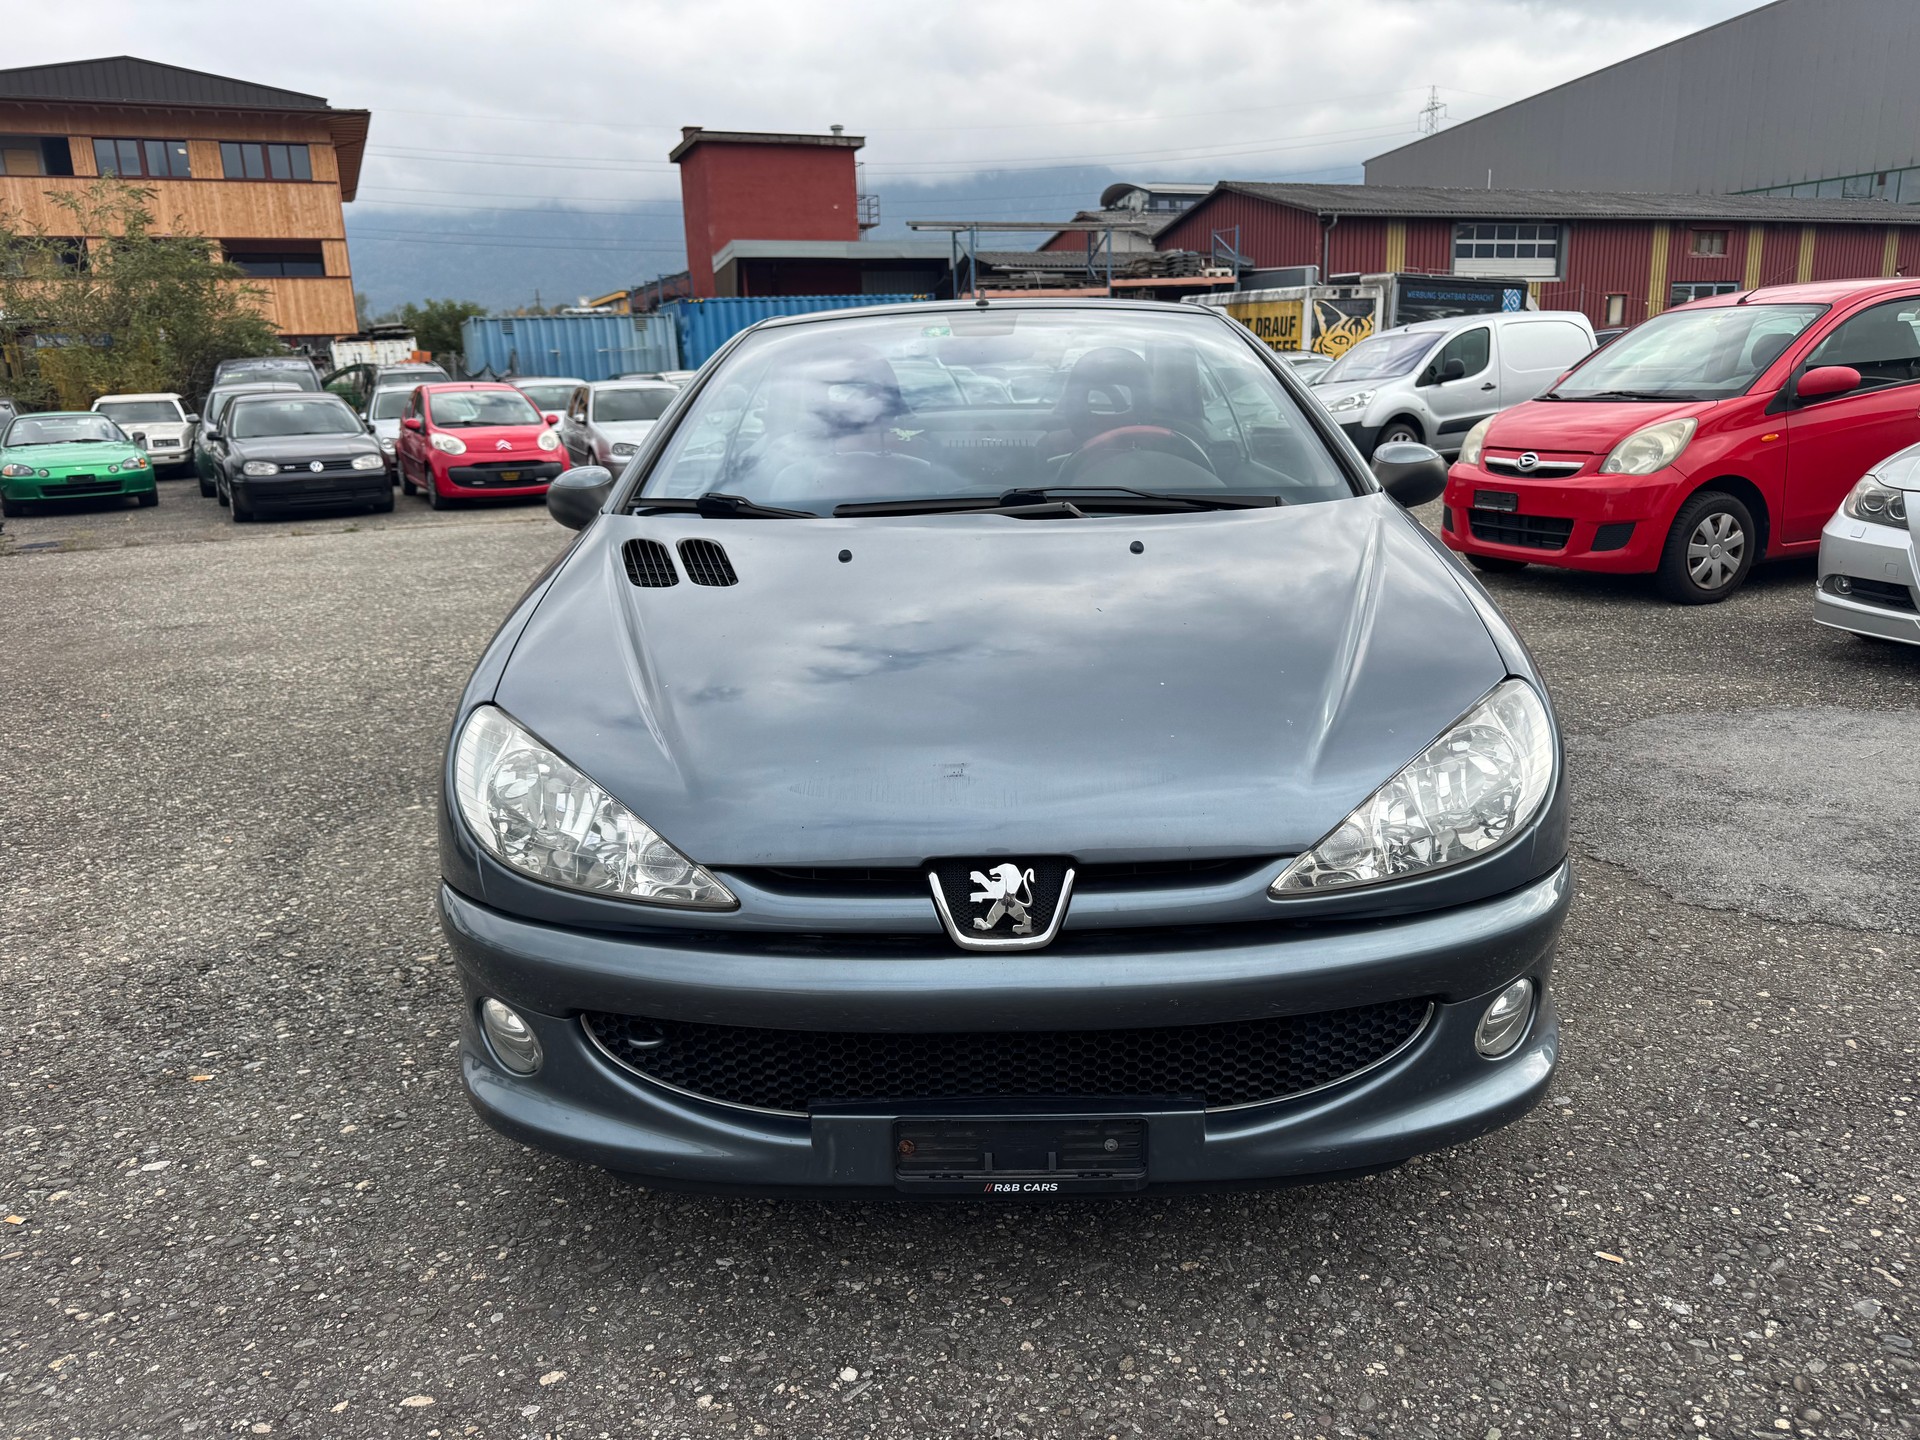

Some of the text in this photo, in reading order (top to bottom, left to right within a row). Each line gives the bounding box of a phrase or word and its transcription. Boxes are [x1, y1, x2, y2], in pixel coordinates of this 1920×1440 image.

[1407, 290, 1495, 302] WERBUNG SICHTBAR GEMACHT
[1255, 315, 1297, 338] DRAUF
[1023, 1183, 1059, 1192] CARS
